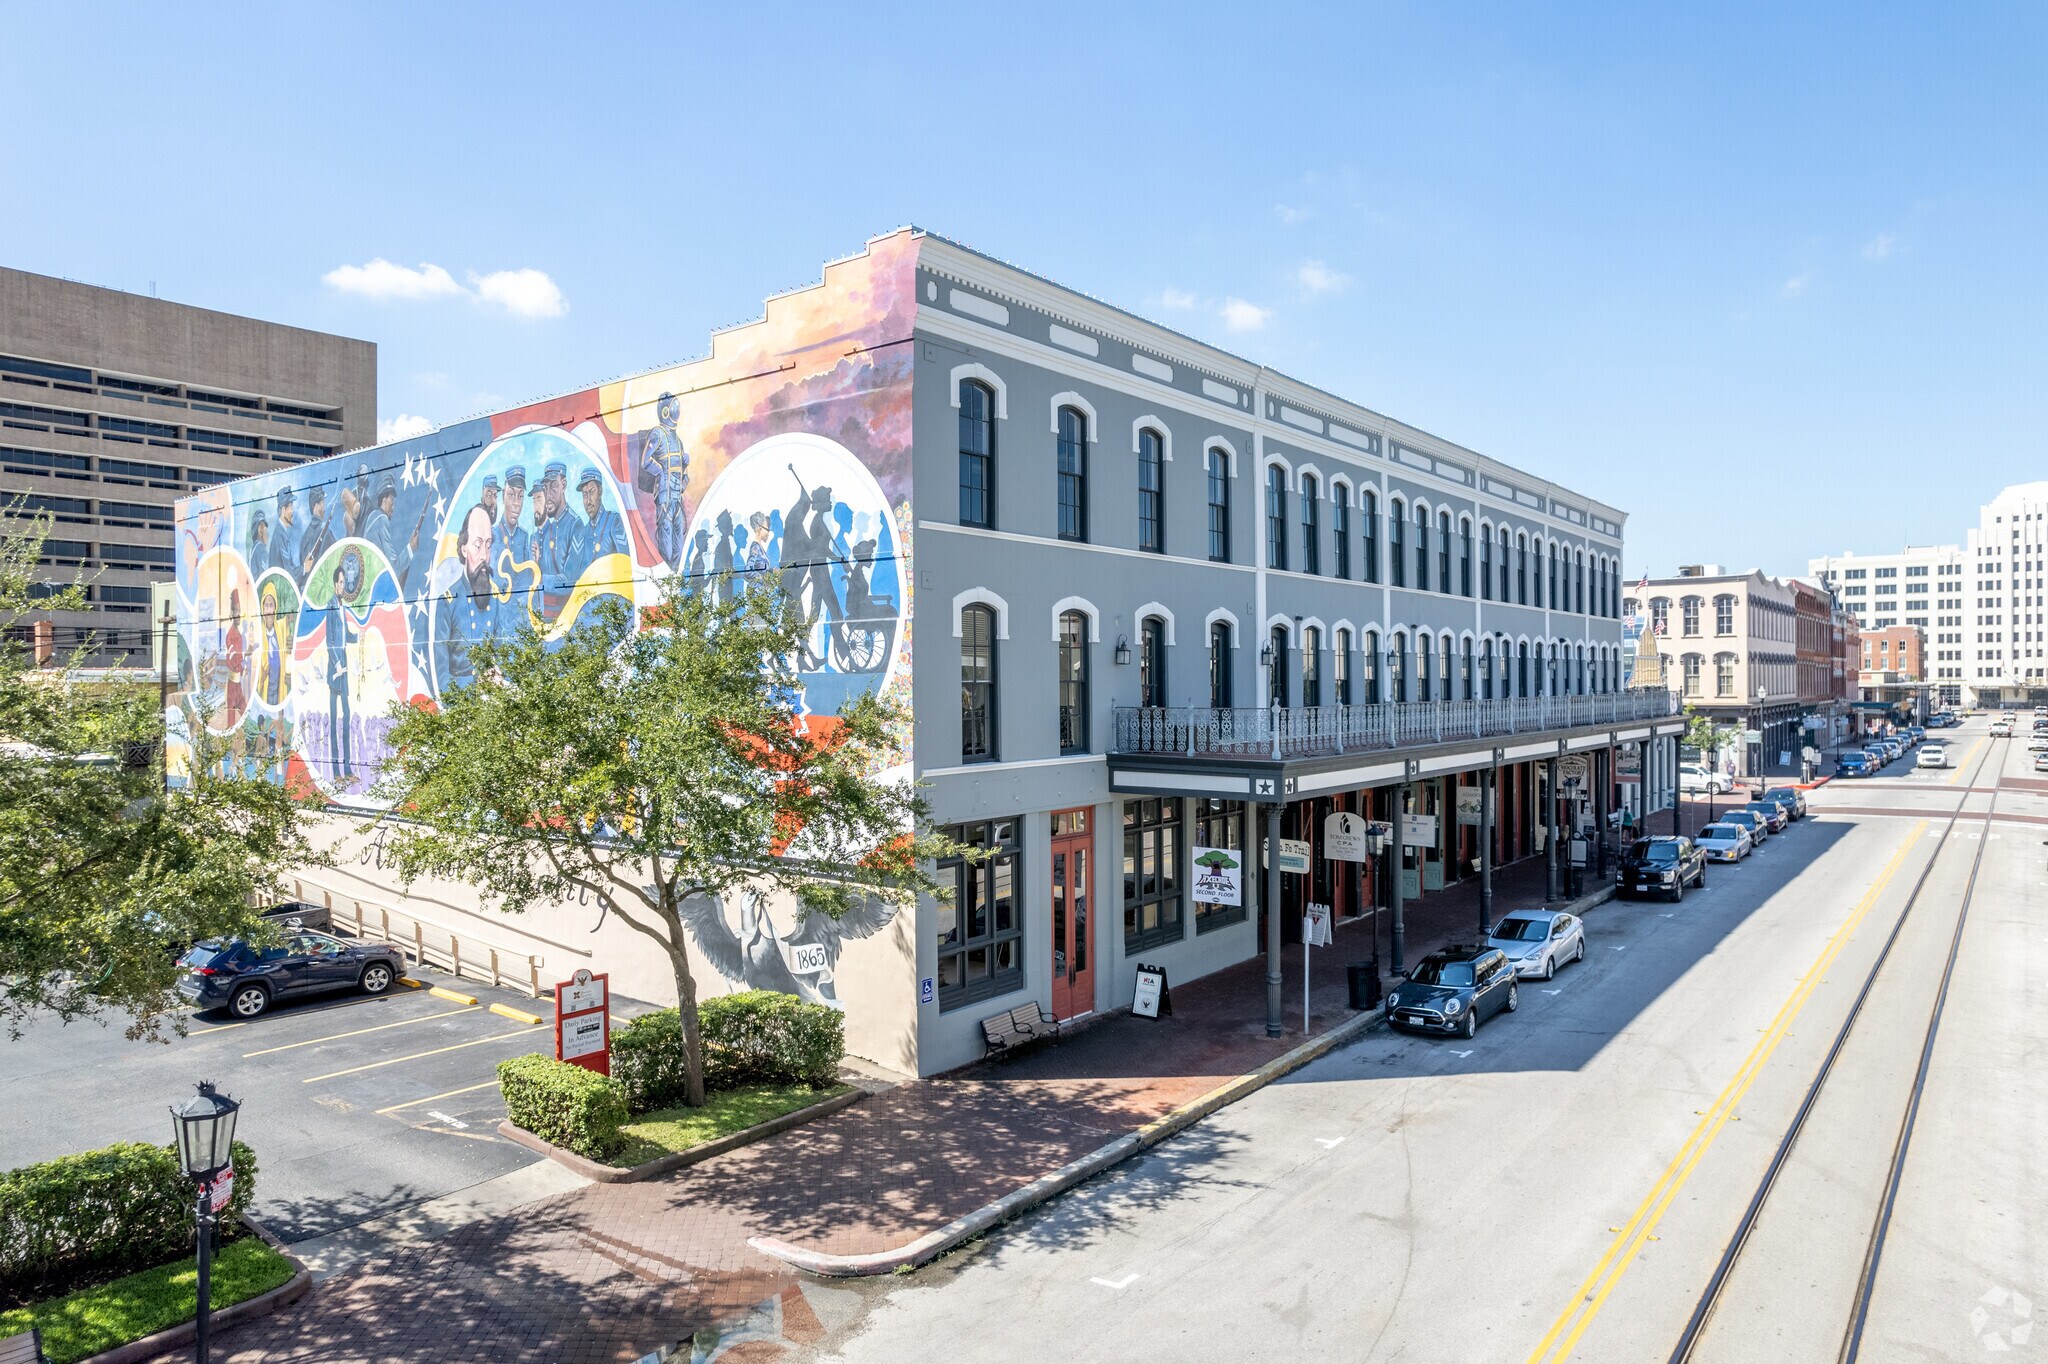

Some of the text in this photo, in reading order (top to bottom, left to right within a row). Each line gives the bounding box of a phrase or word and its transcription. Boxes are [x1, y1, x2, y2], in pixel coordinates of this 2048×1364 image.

[1928, 829, 2001, 841] STOP
[1285, 843, 1293, 852] Fe
[1294, 844, 1310, 857] Trail
[796, 947, 825, 969] 1865
[565, 1021, 579, 1029] Daily
[580, 1015, 602, 1024] Parking
[575, 1032, 599, 1042] Advance
[572, 1041, 585, 1049] Partial
